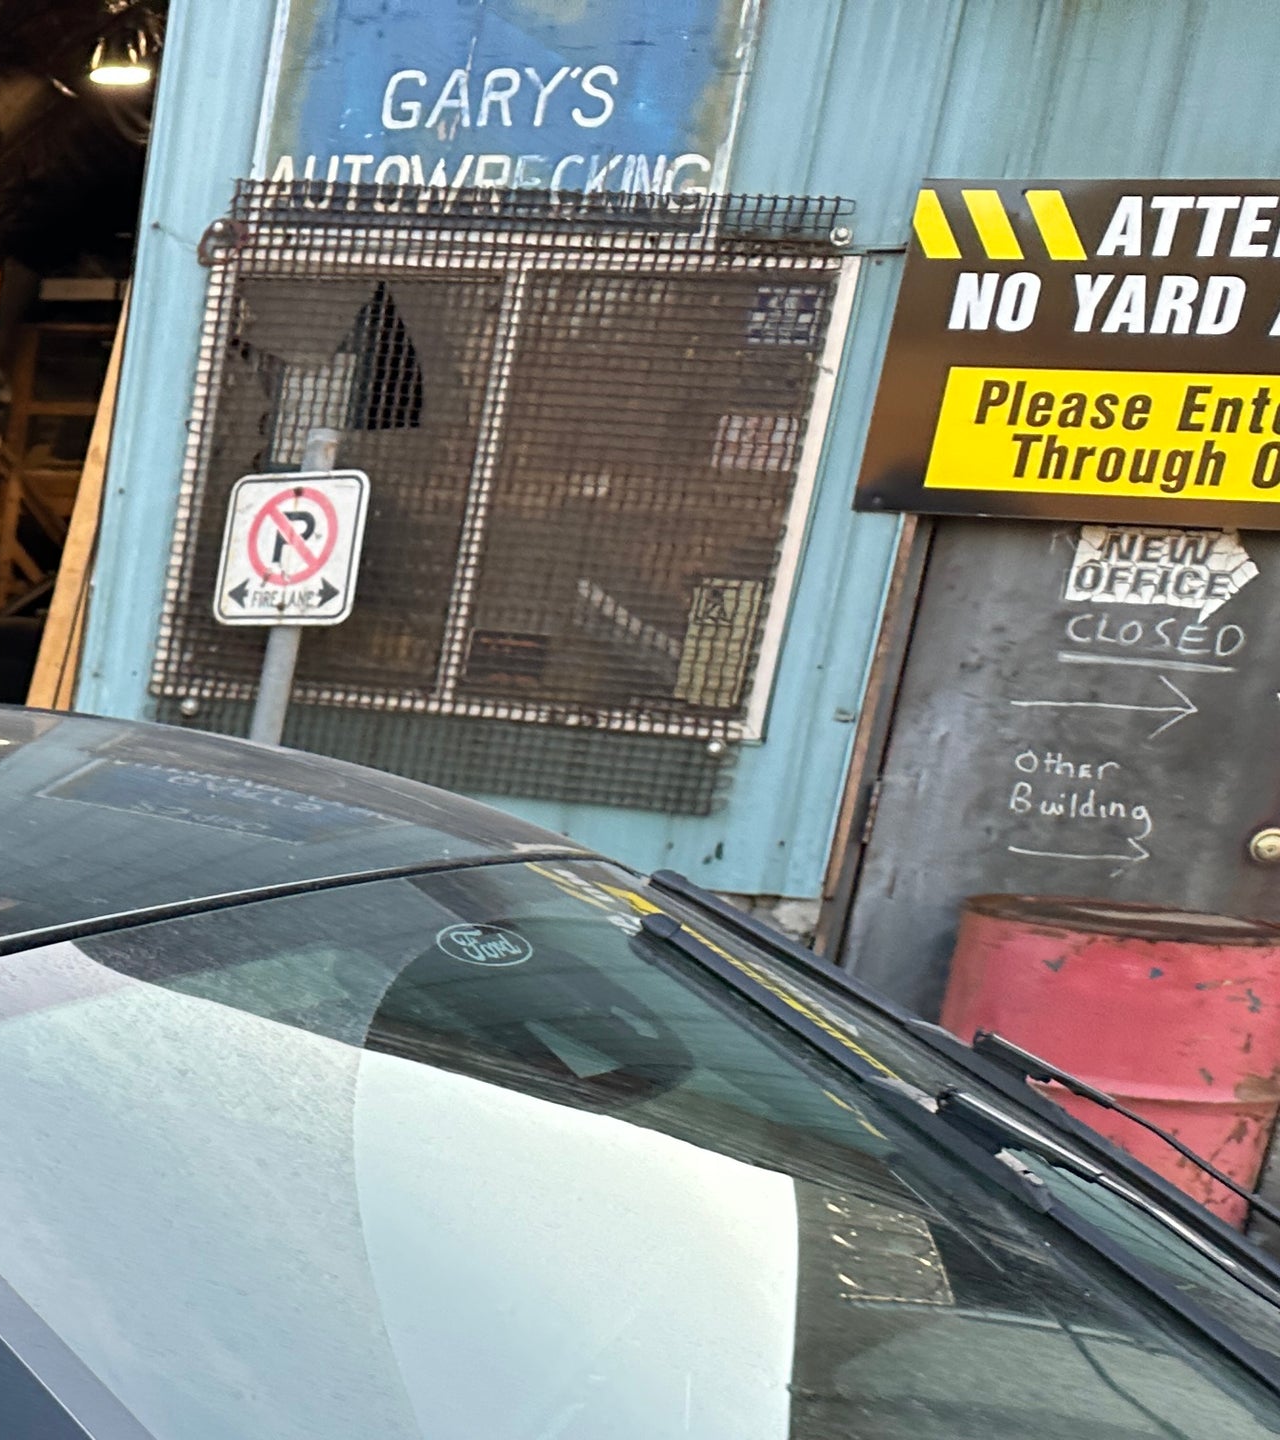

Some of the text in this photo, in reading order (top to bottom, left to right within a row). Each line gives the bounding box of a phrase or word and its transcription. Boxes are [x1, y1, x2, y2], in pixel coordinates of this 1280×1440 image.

[380, 64, 620, 131] GARY'S
[1095, 195, 1280, 259] ATTE
[947, 270, 1042, 333] NO
[1072, 273, 1248, 336] YARD
[973, 378, 1280, 435] Please Ent
[1010, 432, 1228, 494] Through
[1103, 533, 1217, 566] NEW
[250, 590, 278, 607] FIRE
[1074, 559, 1232, 600] OFFICE
[1065, 612, 1247, 657] CLOSED
[1008, 780, 1153, 841] Building
[449, 929, 523, 962] Ford
